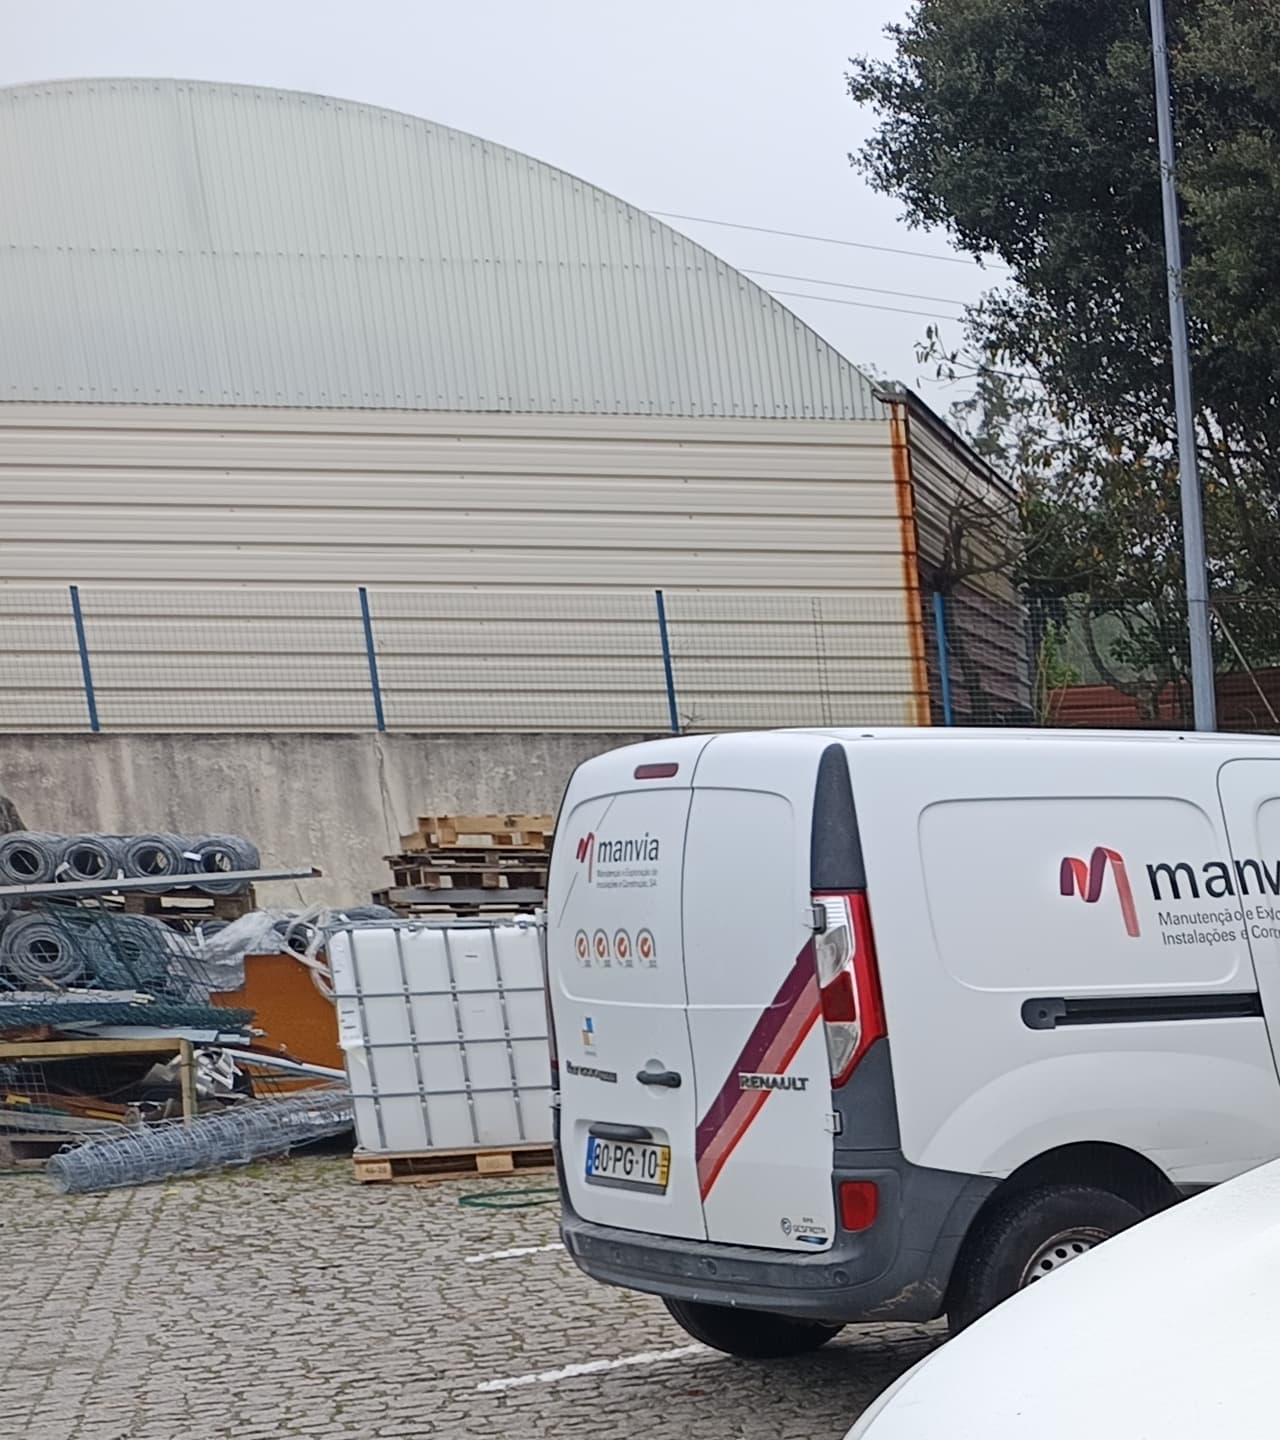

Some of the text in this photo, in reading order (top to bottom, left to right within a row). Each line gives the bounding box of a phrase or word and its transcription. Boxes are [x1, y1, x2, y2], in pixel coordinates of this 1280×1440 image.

[597, 832, 659, 862] manvia
[1158, 908, 1243, 926] Manutenção
[1162, 929, 1236, 947] Instalações
[740, 1075, 809, 1091] RENAULT
